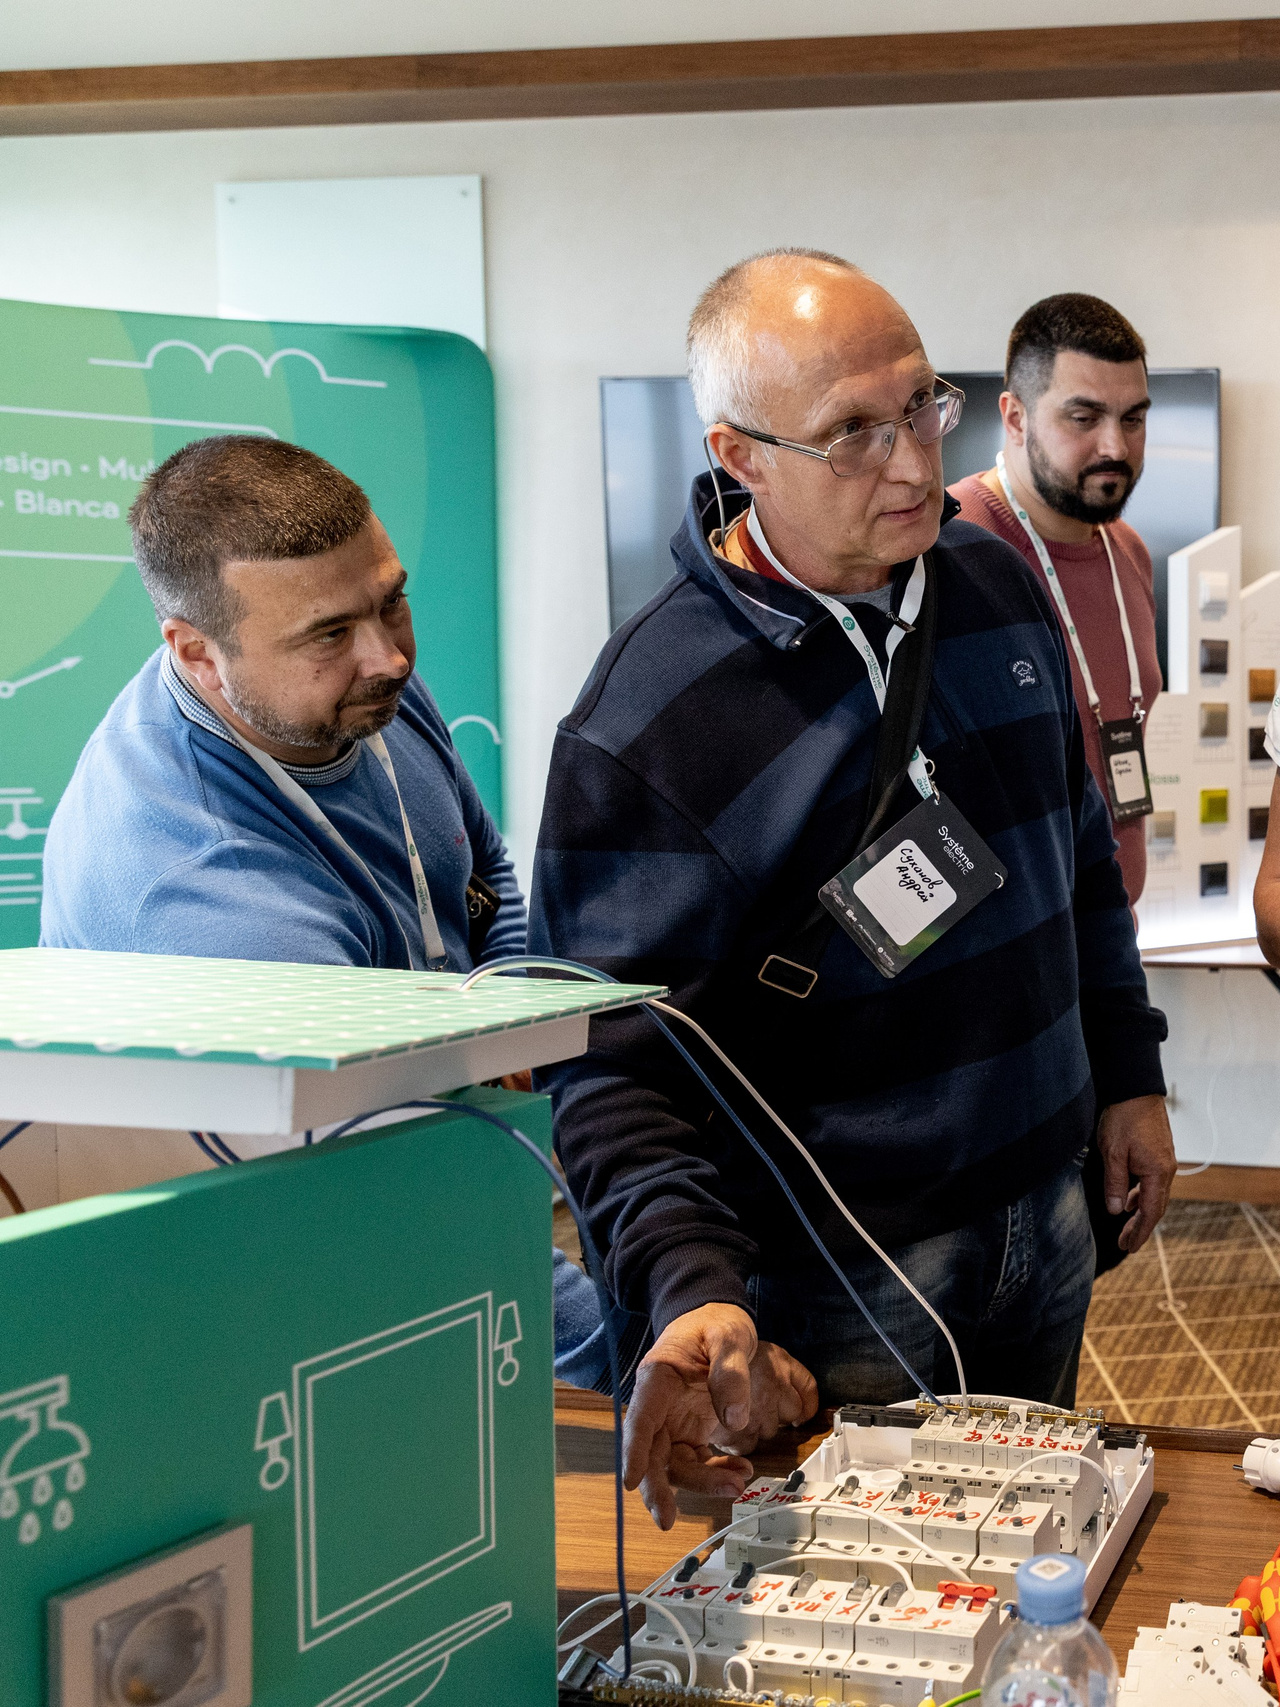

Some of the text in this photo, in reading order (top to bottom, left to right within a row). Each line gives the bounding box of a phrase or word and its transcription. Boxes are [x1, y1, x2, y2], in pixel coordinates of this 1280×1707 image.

[15, 489, 120, 519] Blanca
[863, 644, 883, 690] Systême
[900, 848, 943, 890] Суханов
[938, 825, 975, 871] Systême
[943, 845, 969, 876] electric
